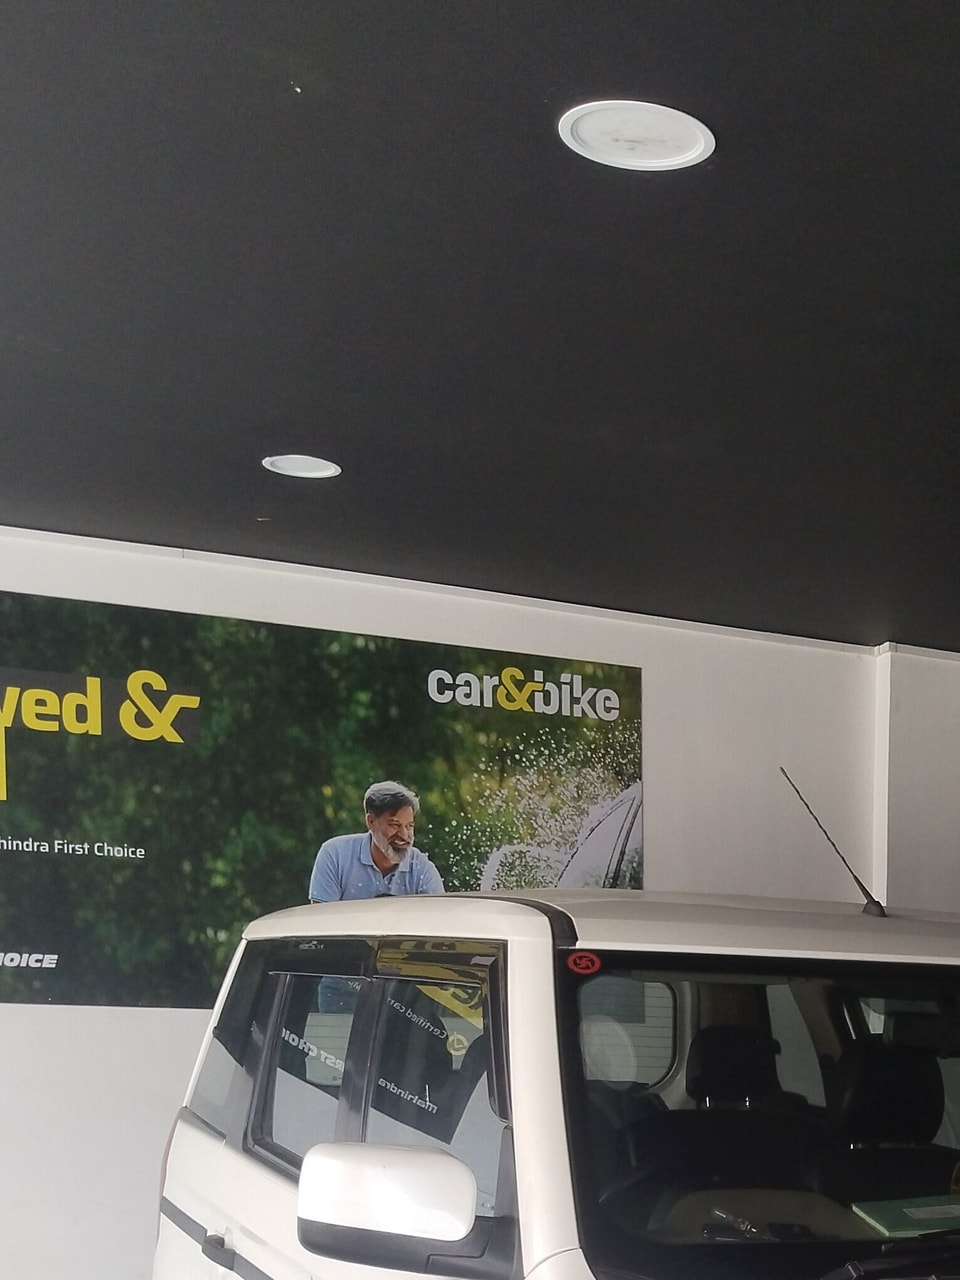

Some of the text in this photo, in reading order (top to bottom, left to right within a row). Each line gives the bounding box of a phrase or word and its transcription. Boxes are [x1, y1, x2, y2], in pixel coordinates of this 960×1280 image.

[119, 669, 201, 743] &
[427, 667, 620, 721] car&bike
[54, 840, 90, 855] First
[94, 843, 146, 859] Choice
